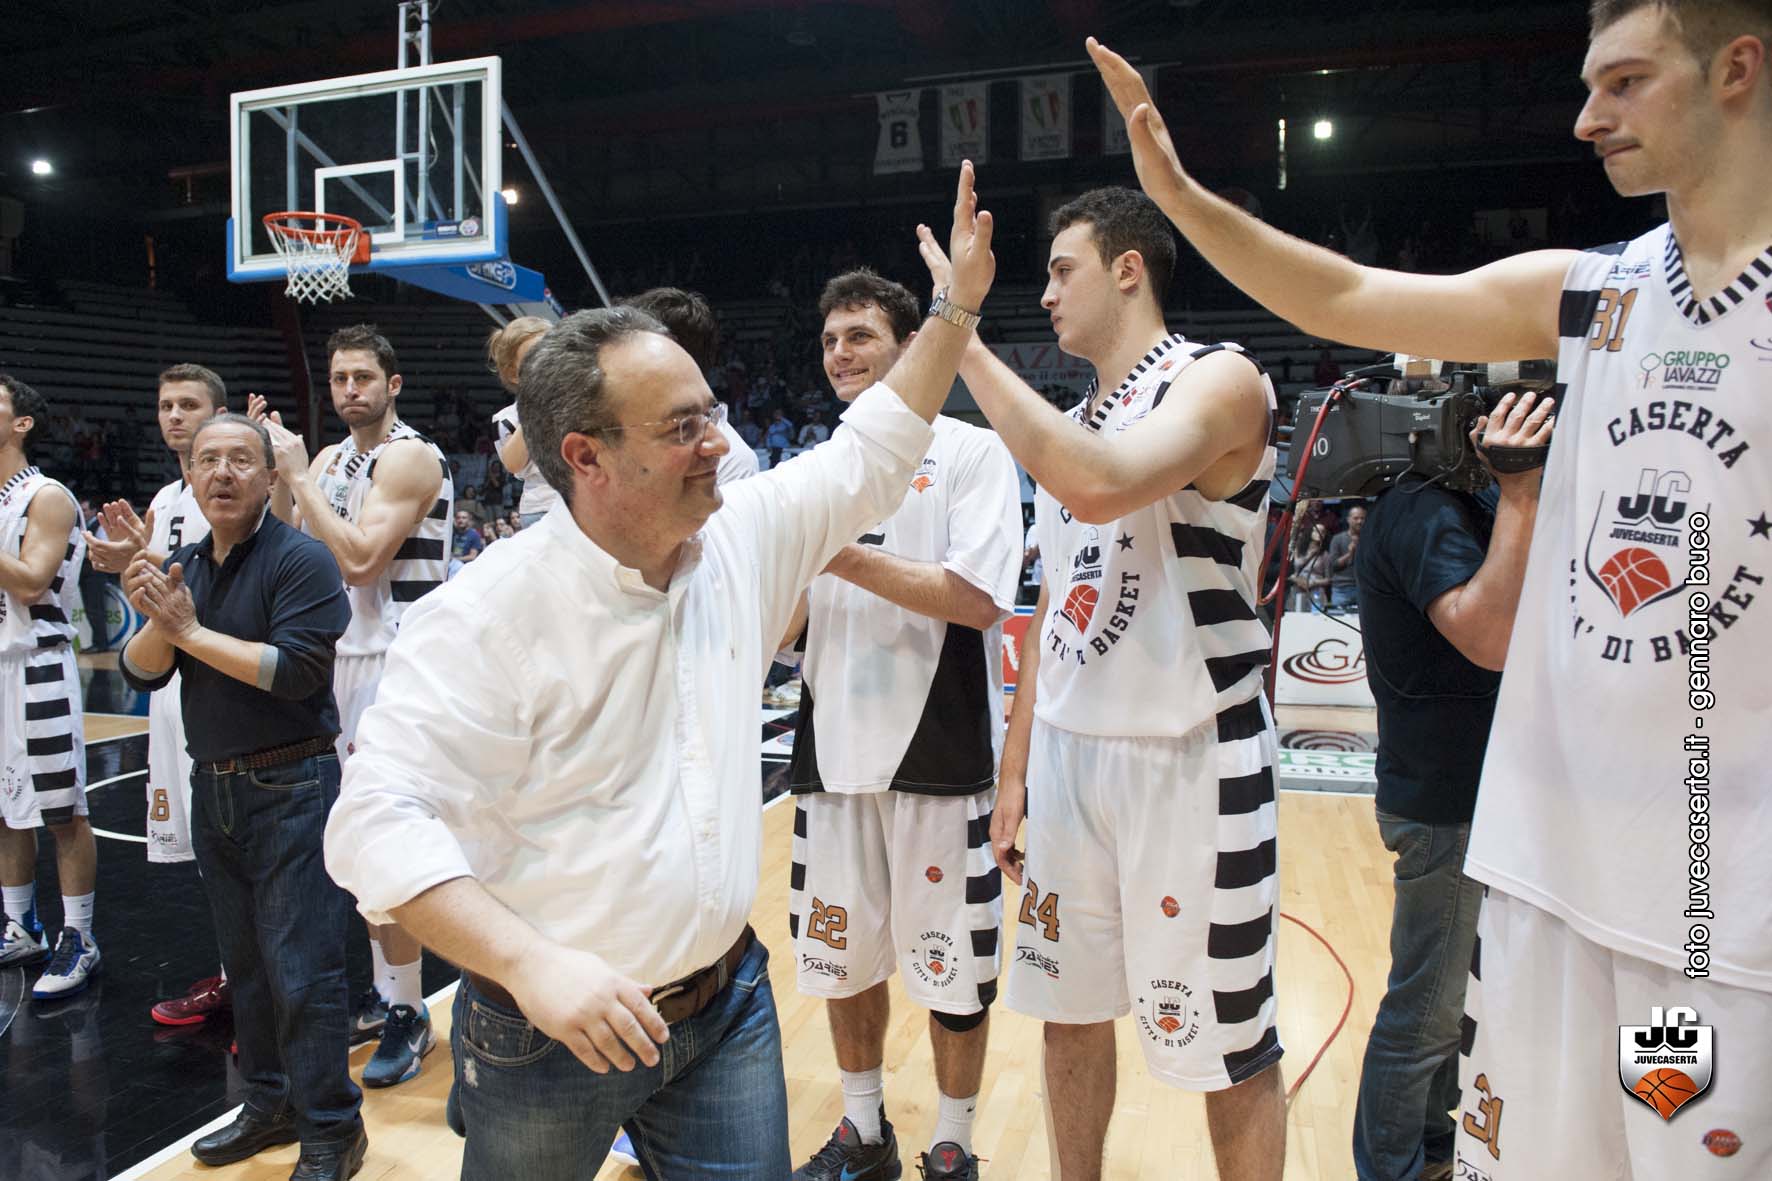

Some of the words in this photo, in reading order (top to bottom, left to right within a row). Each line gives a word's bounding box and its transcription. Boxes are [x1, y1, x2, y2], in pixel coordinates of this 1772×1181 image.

[1663, 350, 1730, 370] GRUPPO
[1607, 400, 1750, 469] CASERTA
[1617, 468, 1692, 525] JC
[1609, 527, 1680, 547] JUVECASERTA
[1090, 571, 1141, 657] BASKET
[1601, 635, 1634, 664] DI
[1650, 565, 1764, 663] BAKET
[806, 896, 848, 950] 22
[1018, 877, 1060, 943] 24
[920, 931, 954, 947] CASERTA
[1150, 979, 1193, 998] CASERTA
